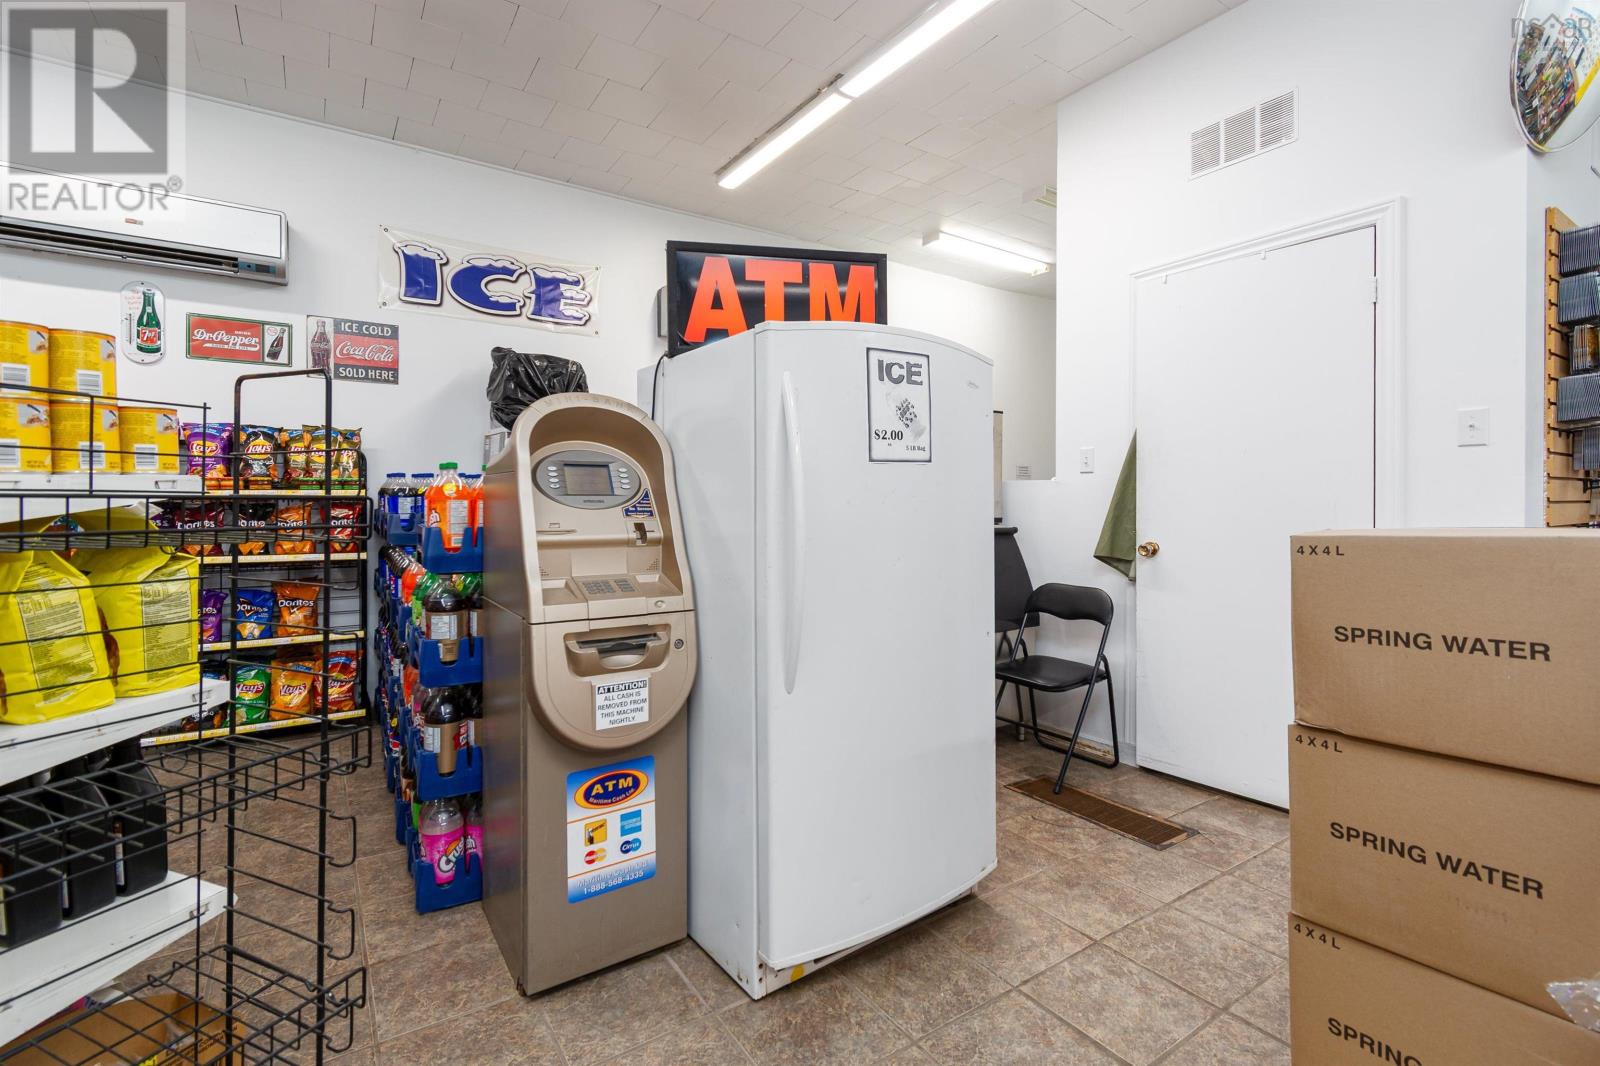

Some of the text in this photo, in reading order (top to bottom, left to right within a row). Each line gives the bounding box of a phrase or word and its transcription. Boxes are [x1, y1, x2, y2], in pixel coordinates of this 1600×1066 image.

[393, 239, 592, 325] ICE
[684, 256, 876, 343] ATM
[341, 322, 392, 336] ICE COLD
[336, 340, 394, 362] Coca-Cola
[339, 367, 395, 380] SOLD HERE
[878, 359, 923, 386] ICE
[874, 429, 904, 441] $2.00
[1334, 626, 1551, 662] SPRING WATER
[597, 680, 647, 695] ATTENTION!
[598, 701, 628, 710] REMOVED
[616, 706, 644, 716] MACHINE
[609, 715, 636, 725] NIGHTLY
[591, 776, 633, 797] ATM
[1330, 822, 1544, 900] SPRING WATER
